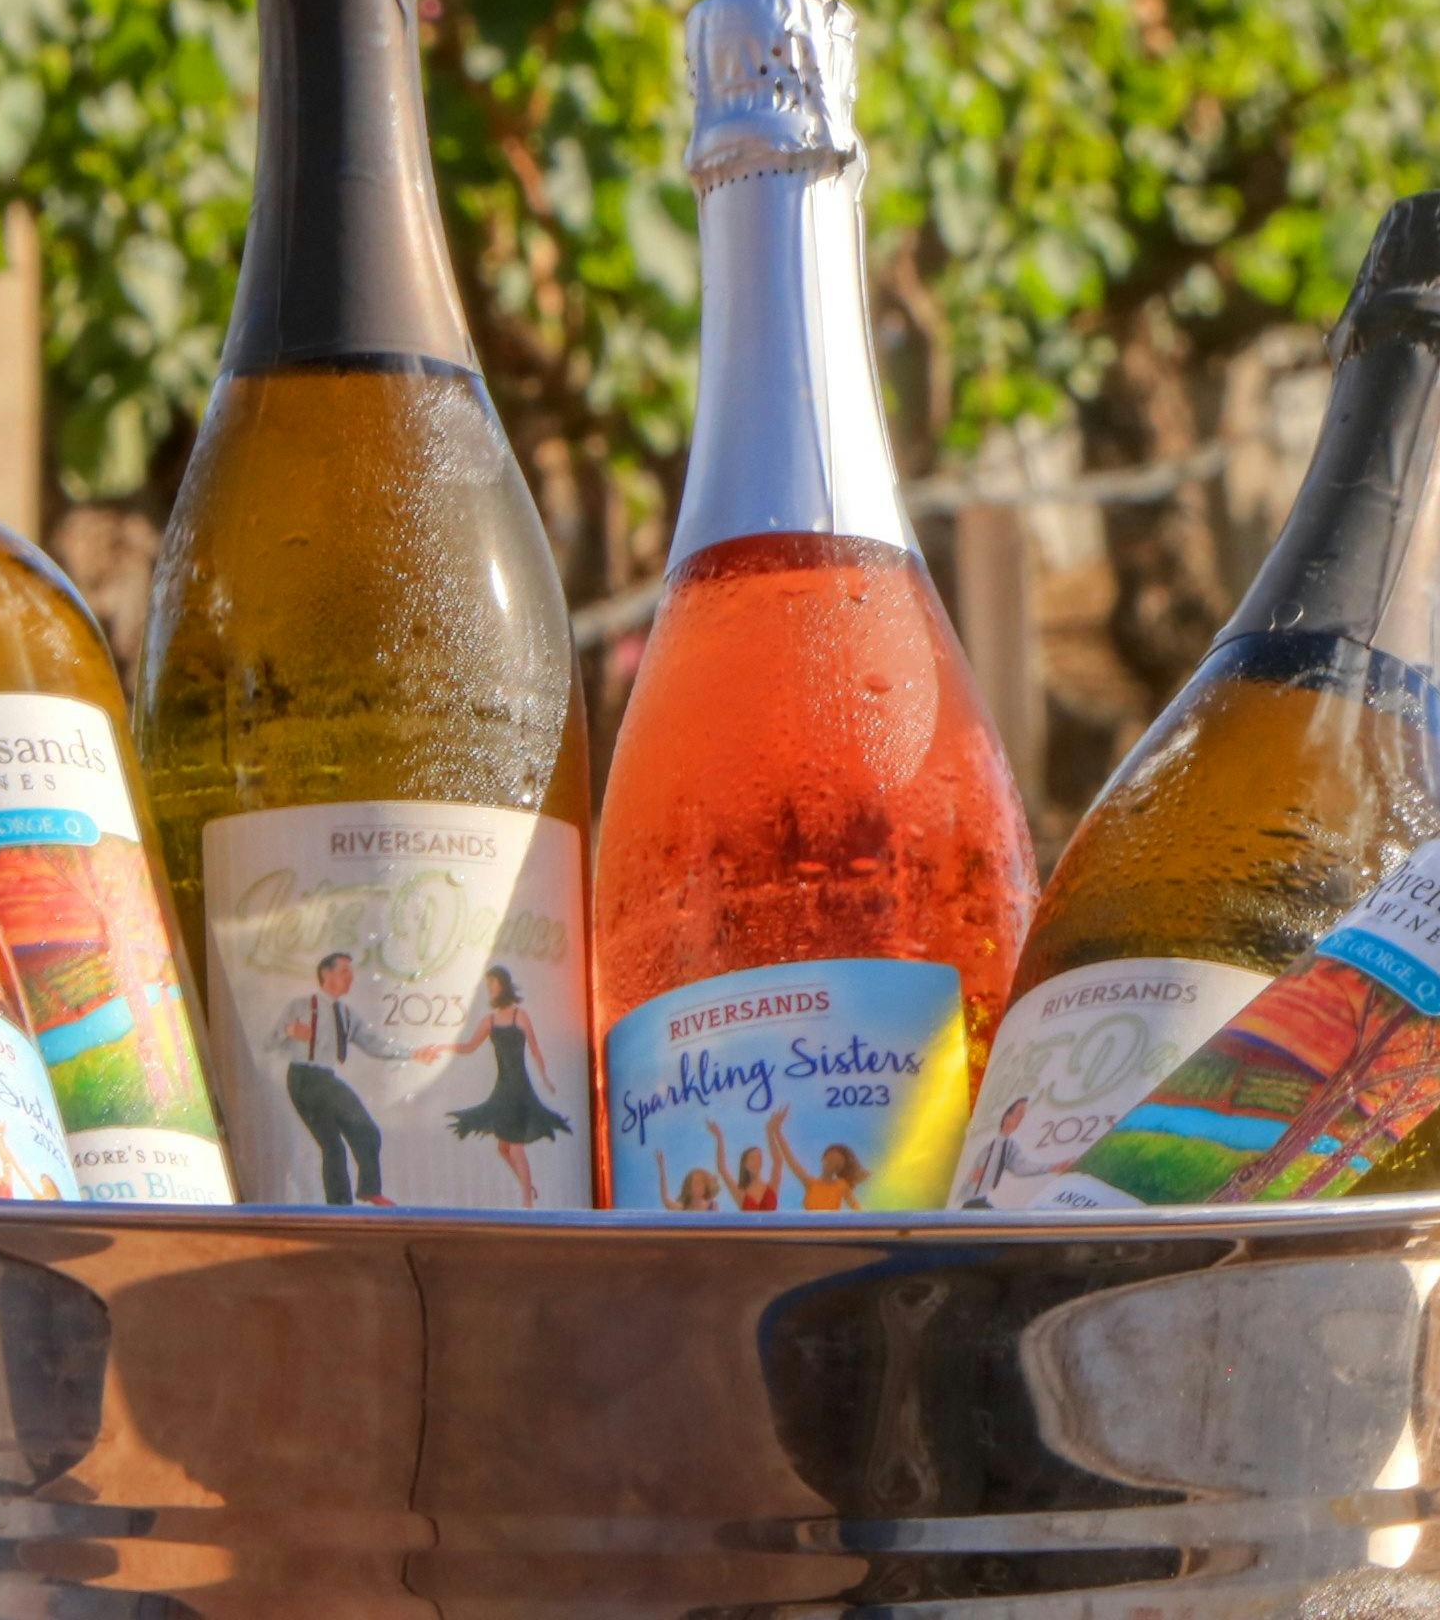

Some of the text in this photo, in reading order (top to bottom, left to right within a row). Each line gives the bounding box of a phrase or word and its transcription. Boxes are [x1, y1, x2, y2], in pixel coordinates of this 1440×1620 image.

[329, 830, 498, 858] RIVERSANDS
[381, 993, 468, 1028] 2023
[668, 990, 831, 1042] RIVERSANDS
[1041, 981, 1200, 1019] RIVERSANDS
[621, 1034, 926, 1147] Sparkling Sisters
[825, 1084, 891, 1109] 2023
[152, 1150, 191, 1168] DRY
